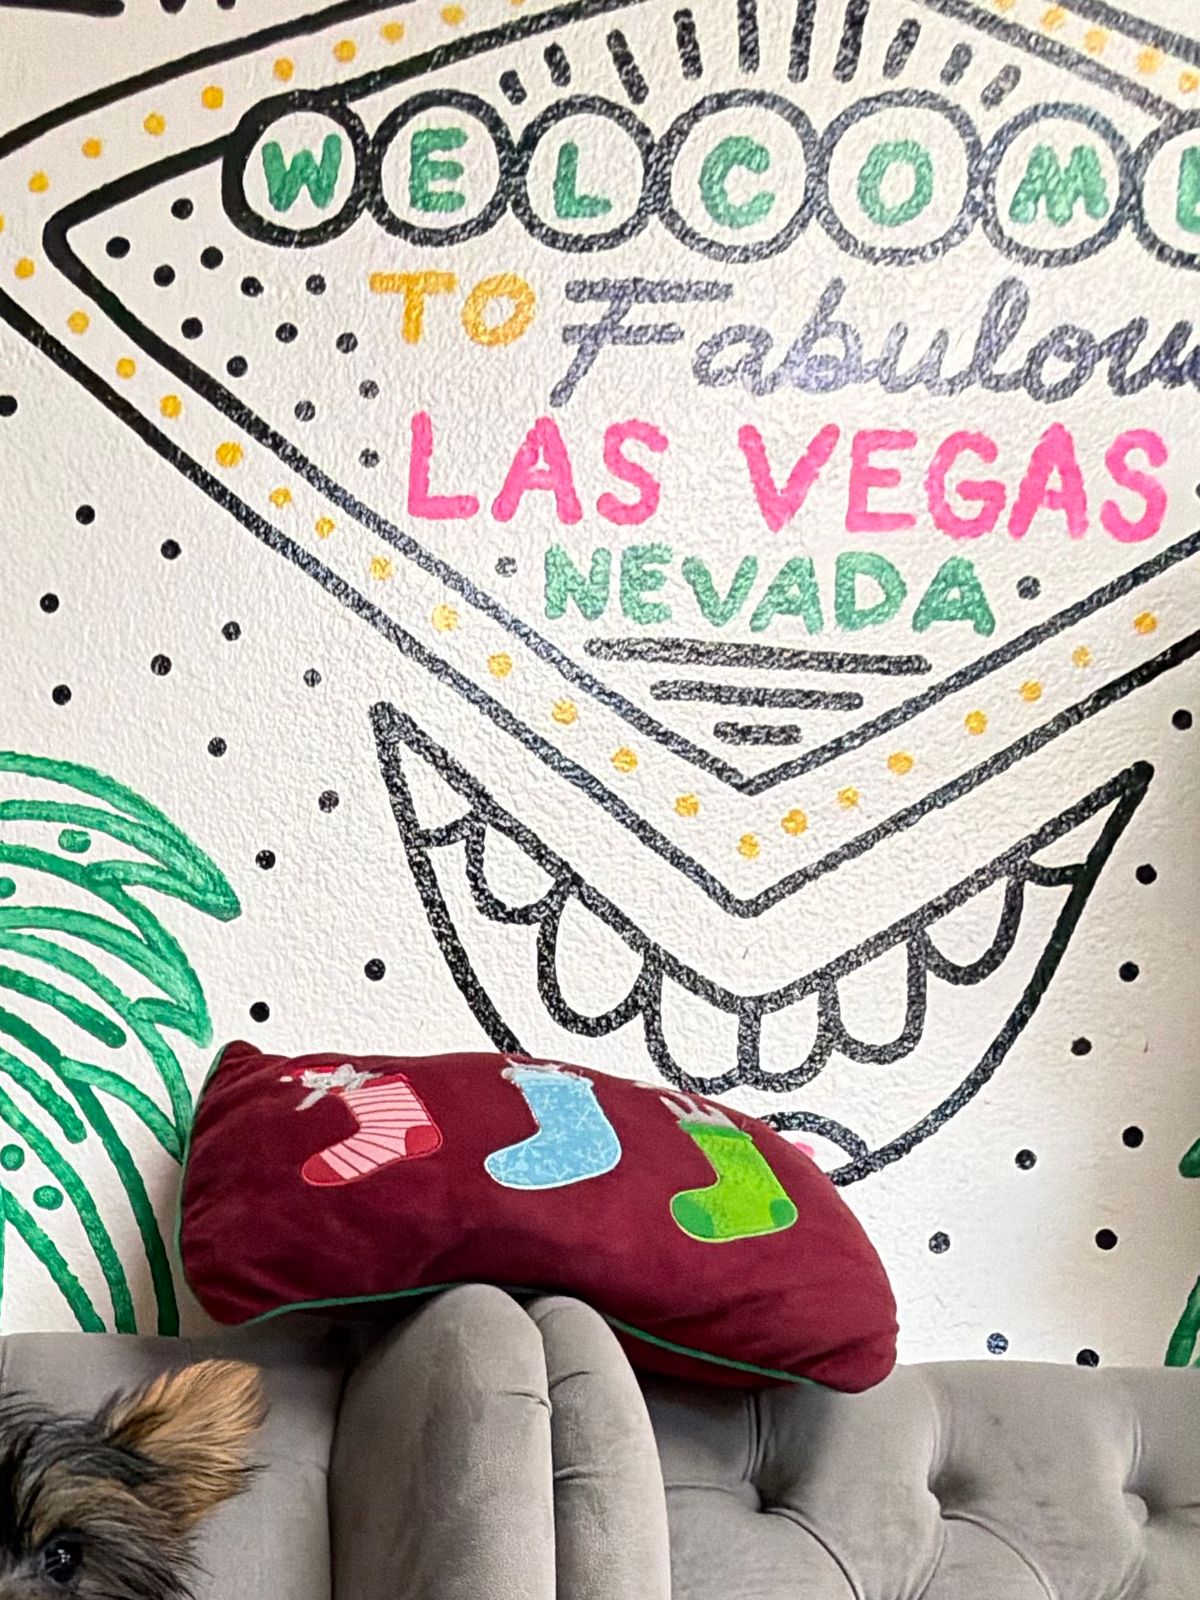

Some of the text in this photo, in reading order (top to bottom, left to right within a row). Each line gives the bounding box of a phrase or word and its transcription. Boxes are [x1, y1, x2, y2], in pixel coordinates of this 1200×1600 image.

[369, 270, 1200, 405] TO Fabulou
[406, 411, 1169, 544] LAS VEGAS
[544, 542, 997, 636] NEVADA
